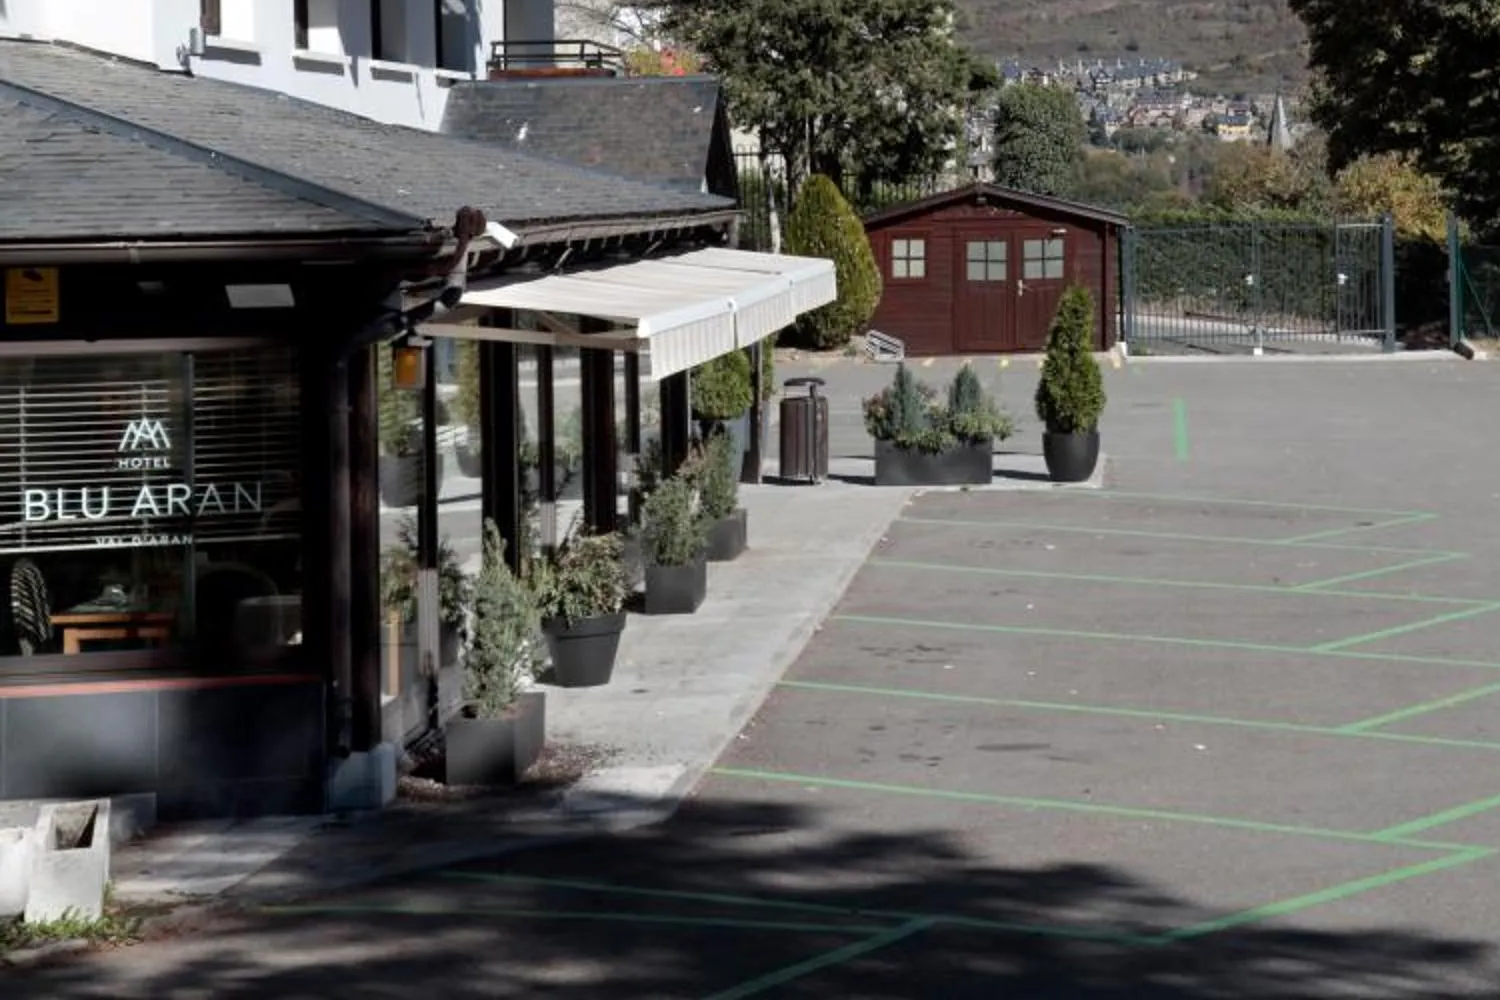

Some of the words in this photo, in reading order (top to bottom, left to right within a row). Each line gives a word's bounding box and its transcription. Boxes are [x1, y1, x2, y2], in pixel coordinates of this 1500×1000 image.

[118, 457, 171, 469] HOTEL
[25, 486, 110, 522] BLU
[131, 482, 262, 517] ARAN
